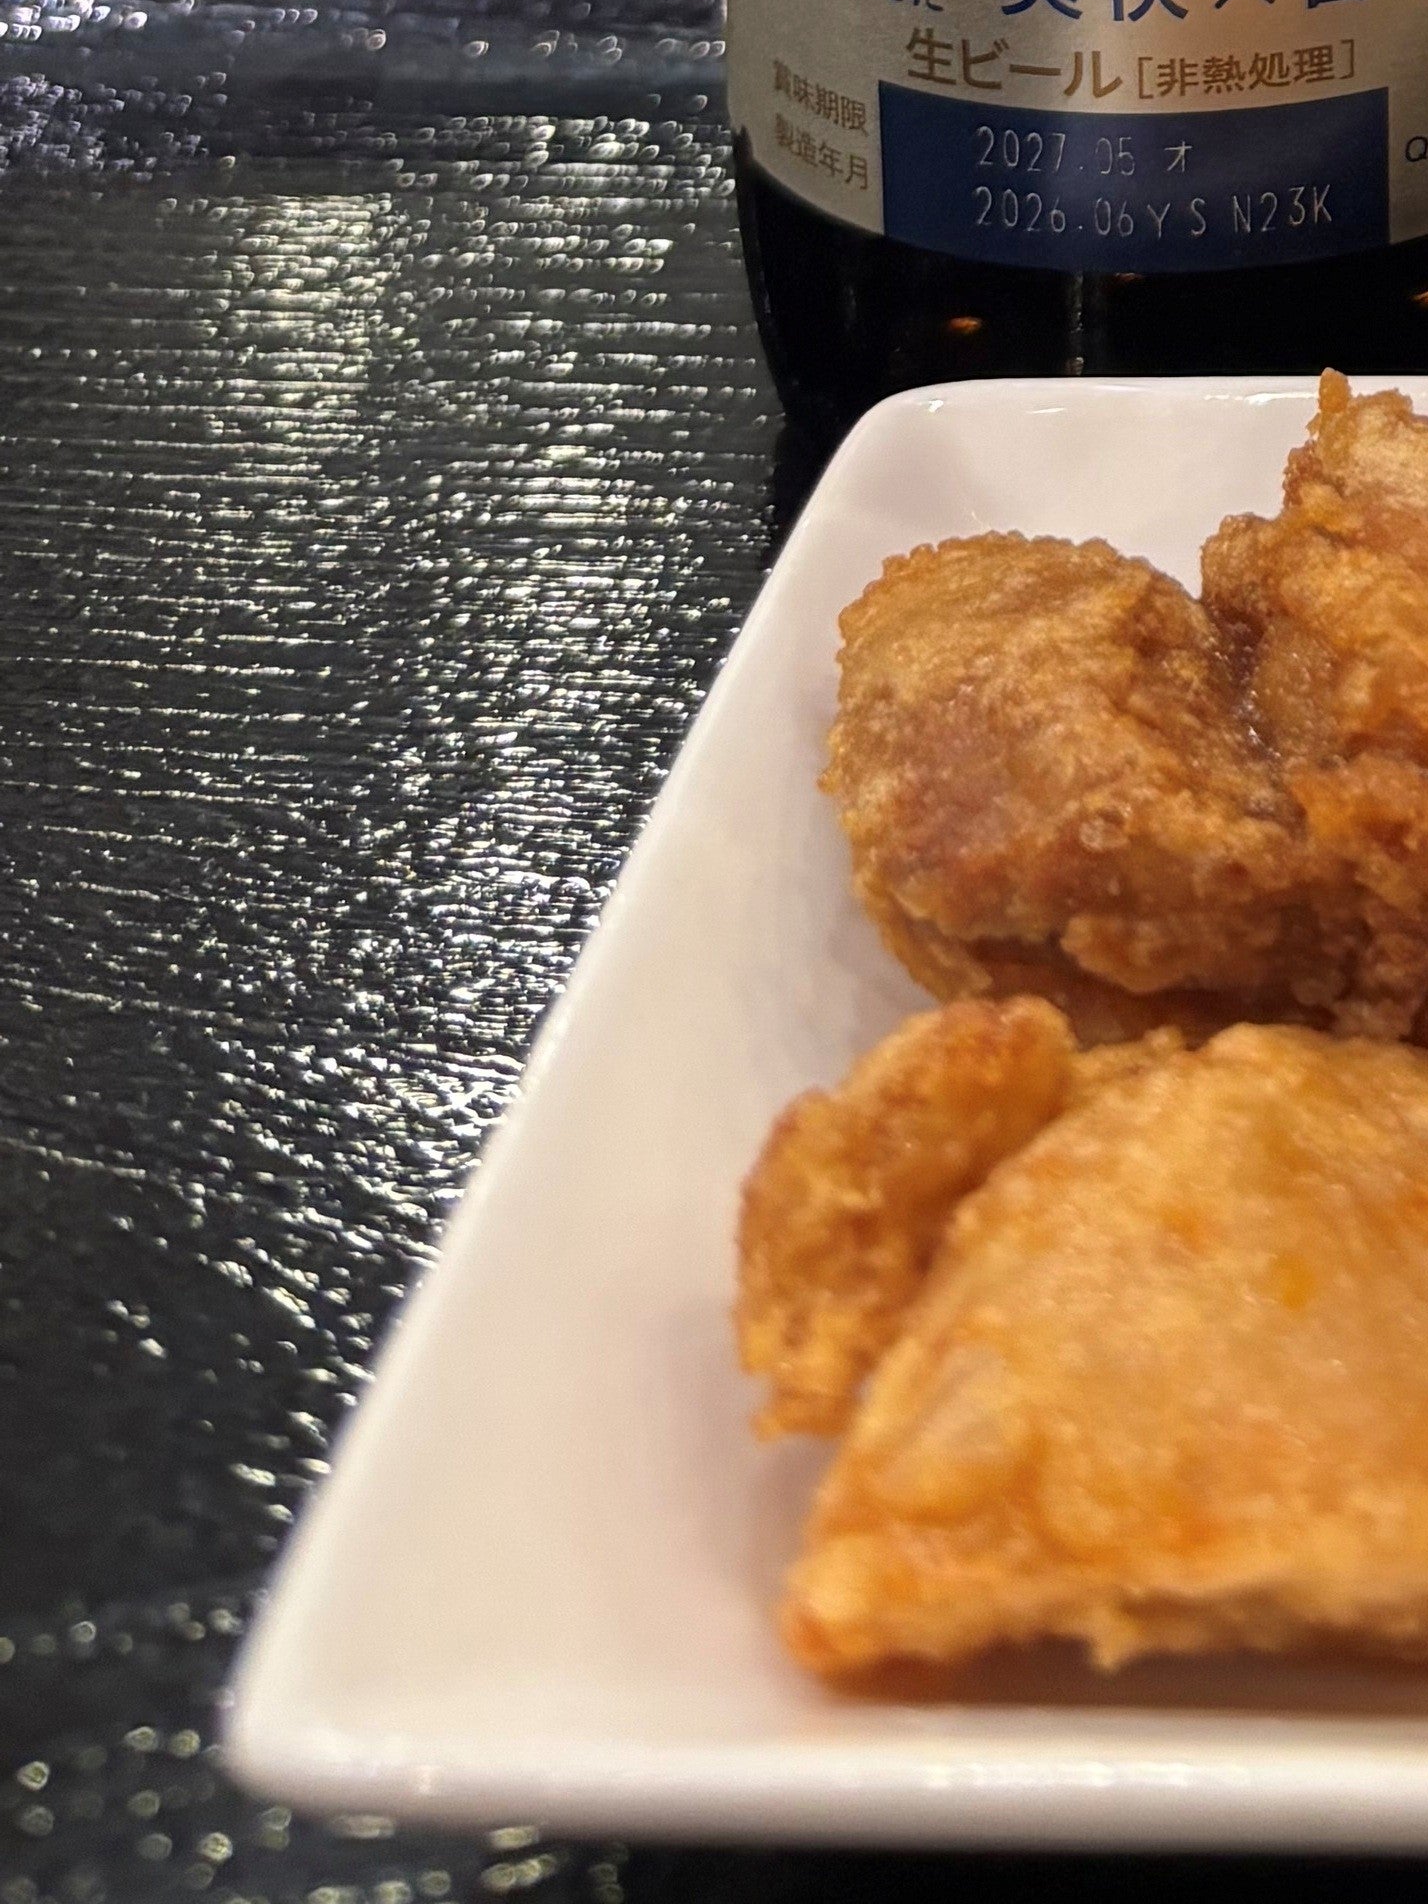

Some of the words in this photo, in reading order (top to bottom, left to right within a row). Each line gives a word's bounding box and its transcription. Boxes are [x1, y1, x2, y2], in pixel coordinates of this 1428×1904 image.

[773, 57, 871, 139] 賞味期限
[774, 111, 870, 192] 製造年月
[974, 124, 1137, 177] 2027.05
